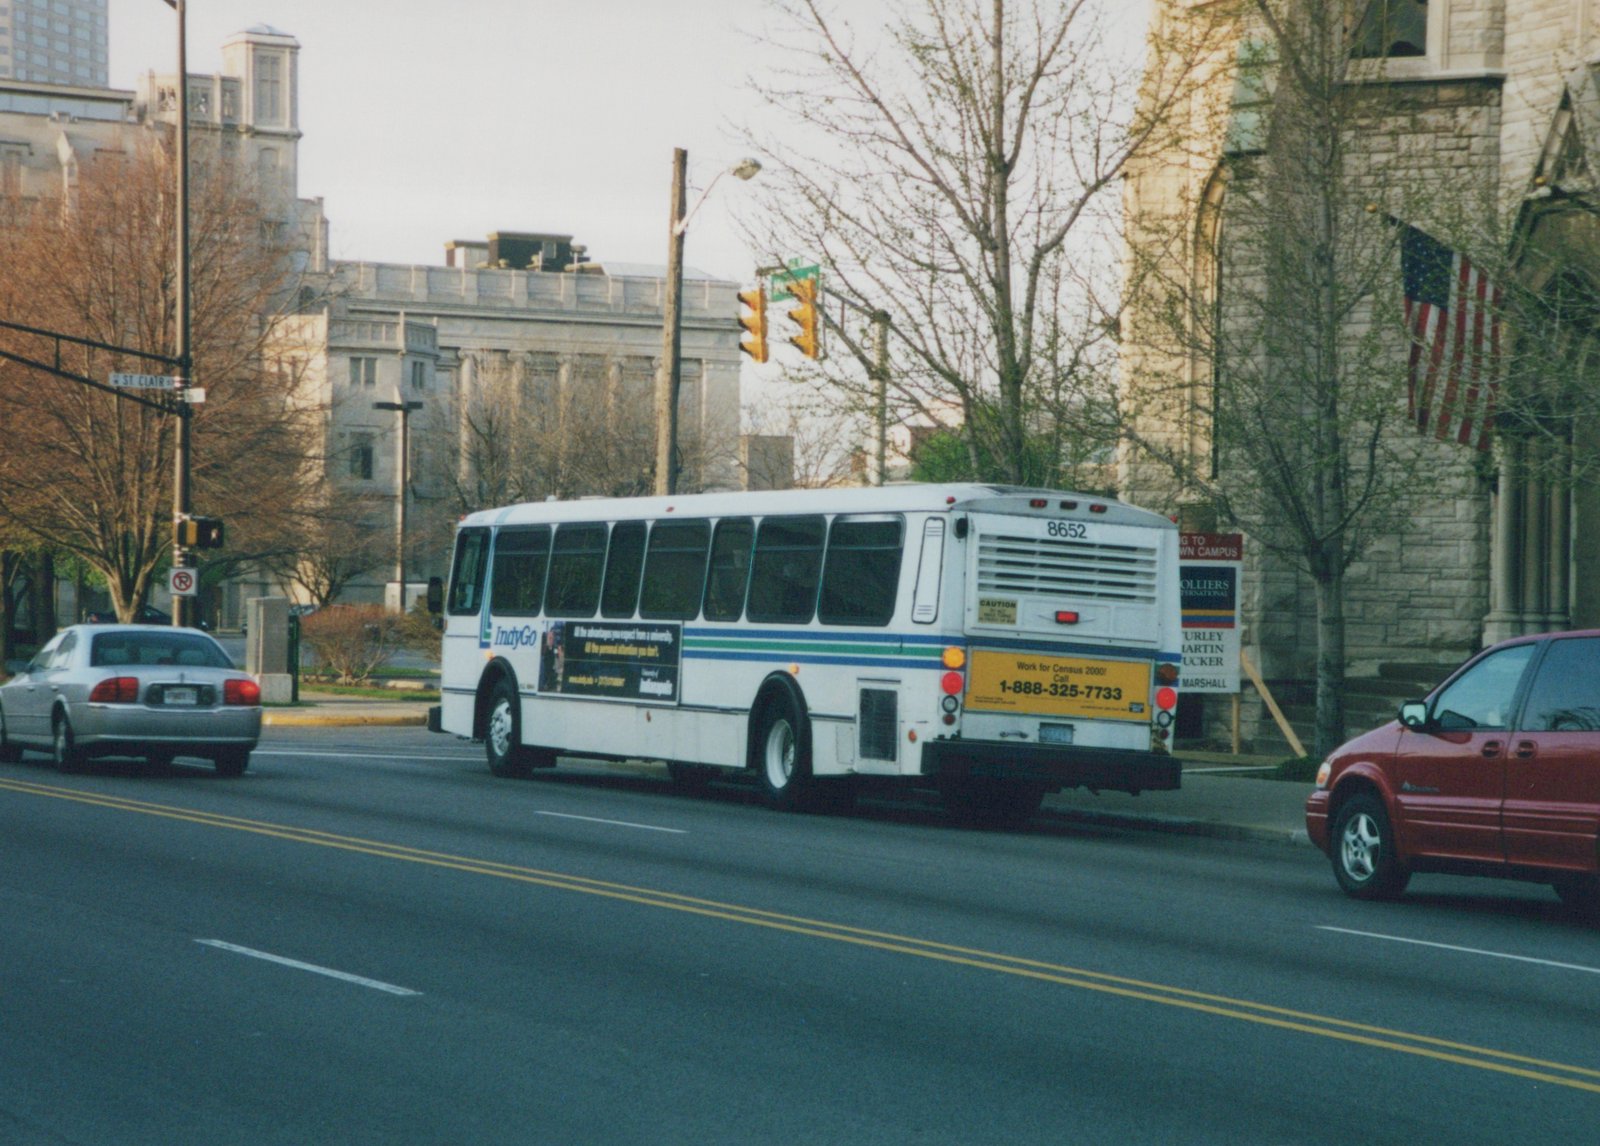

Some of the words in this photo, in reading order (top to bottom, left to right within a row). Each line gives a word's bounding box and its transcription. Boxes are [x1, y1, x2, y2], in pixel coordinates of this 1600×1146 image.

[138, 376, 165, 387] CLAIR
[1047, 521, 1088, 539] 8652
[1192, 535, 1205, 546] TO
[1197, 547, 1238, 557] CAMPUS
[1180, 578, 1229, 590] OLLIERS
[979, 600, 1017, 609] CAUTION
[494, 624, 537, 650] IndyGo
[1183, 656, 1224, 667] UCKER
[1016, 661, 1037, 671] Work
[1039, 662, 1051, 672] for
[1053, 663, 1083, 675] Census
[1085, 665, 1107, 676] 2000!
[1053, 674, 1070, 684] Call
[1182, 678, 1228, 689] MARSHALL
[999, 680, 1122, 701] 1-888-325-7733
